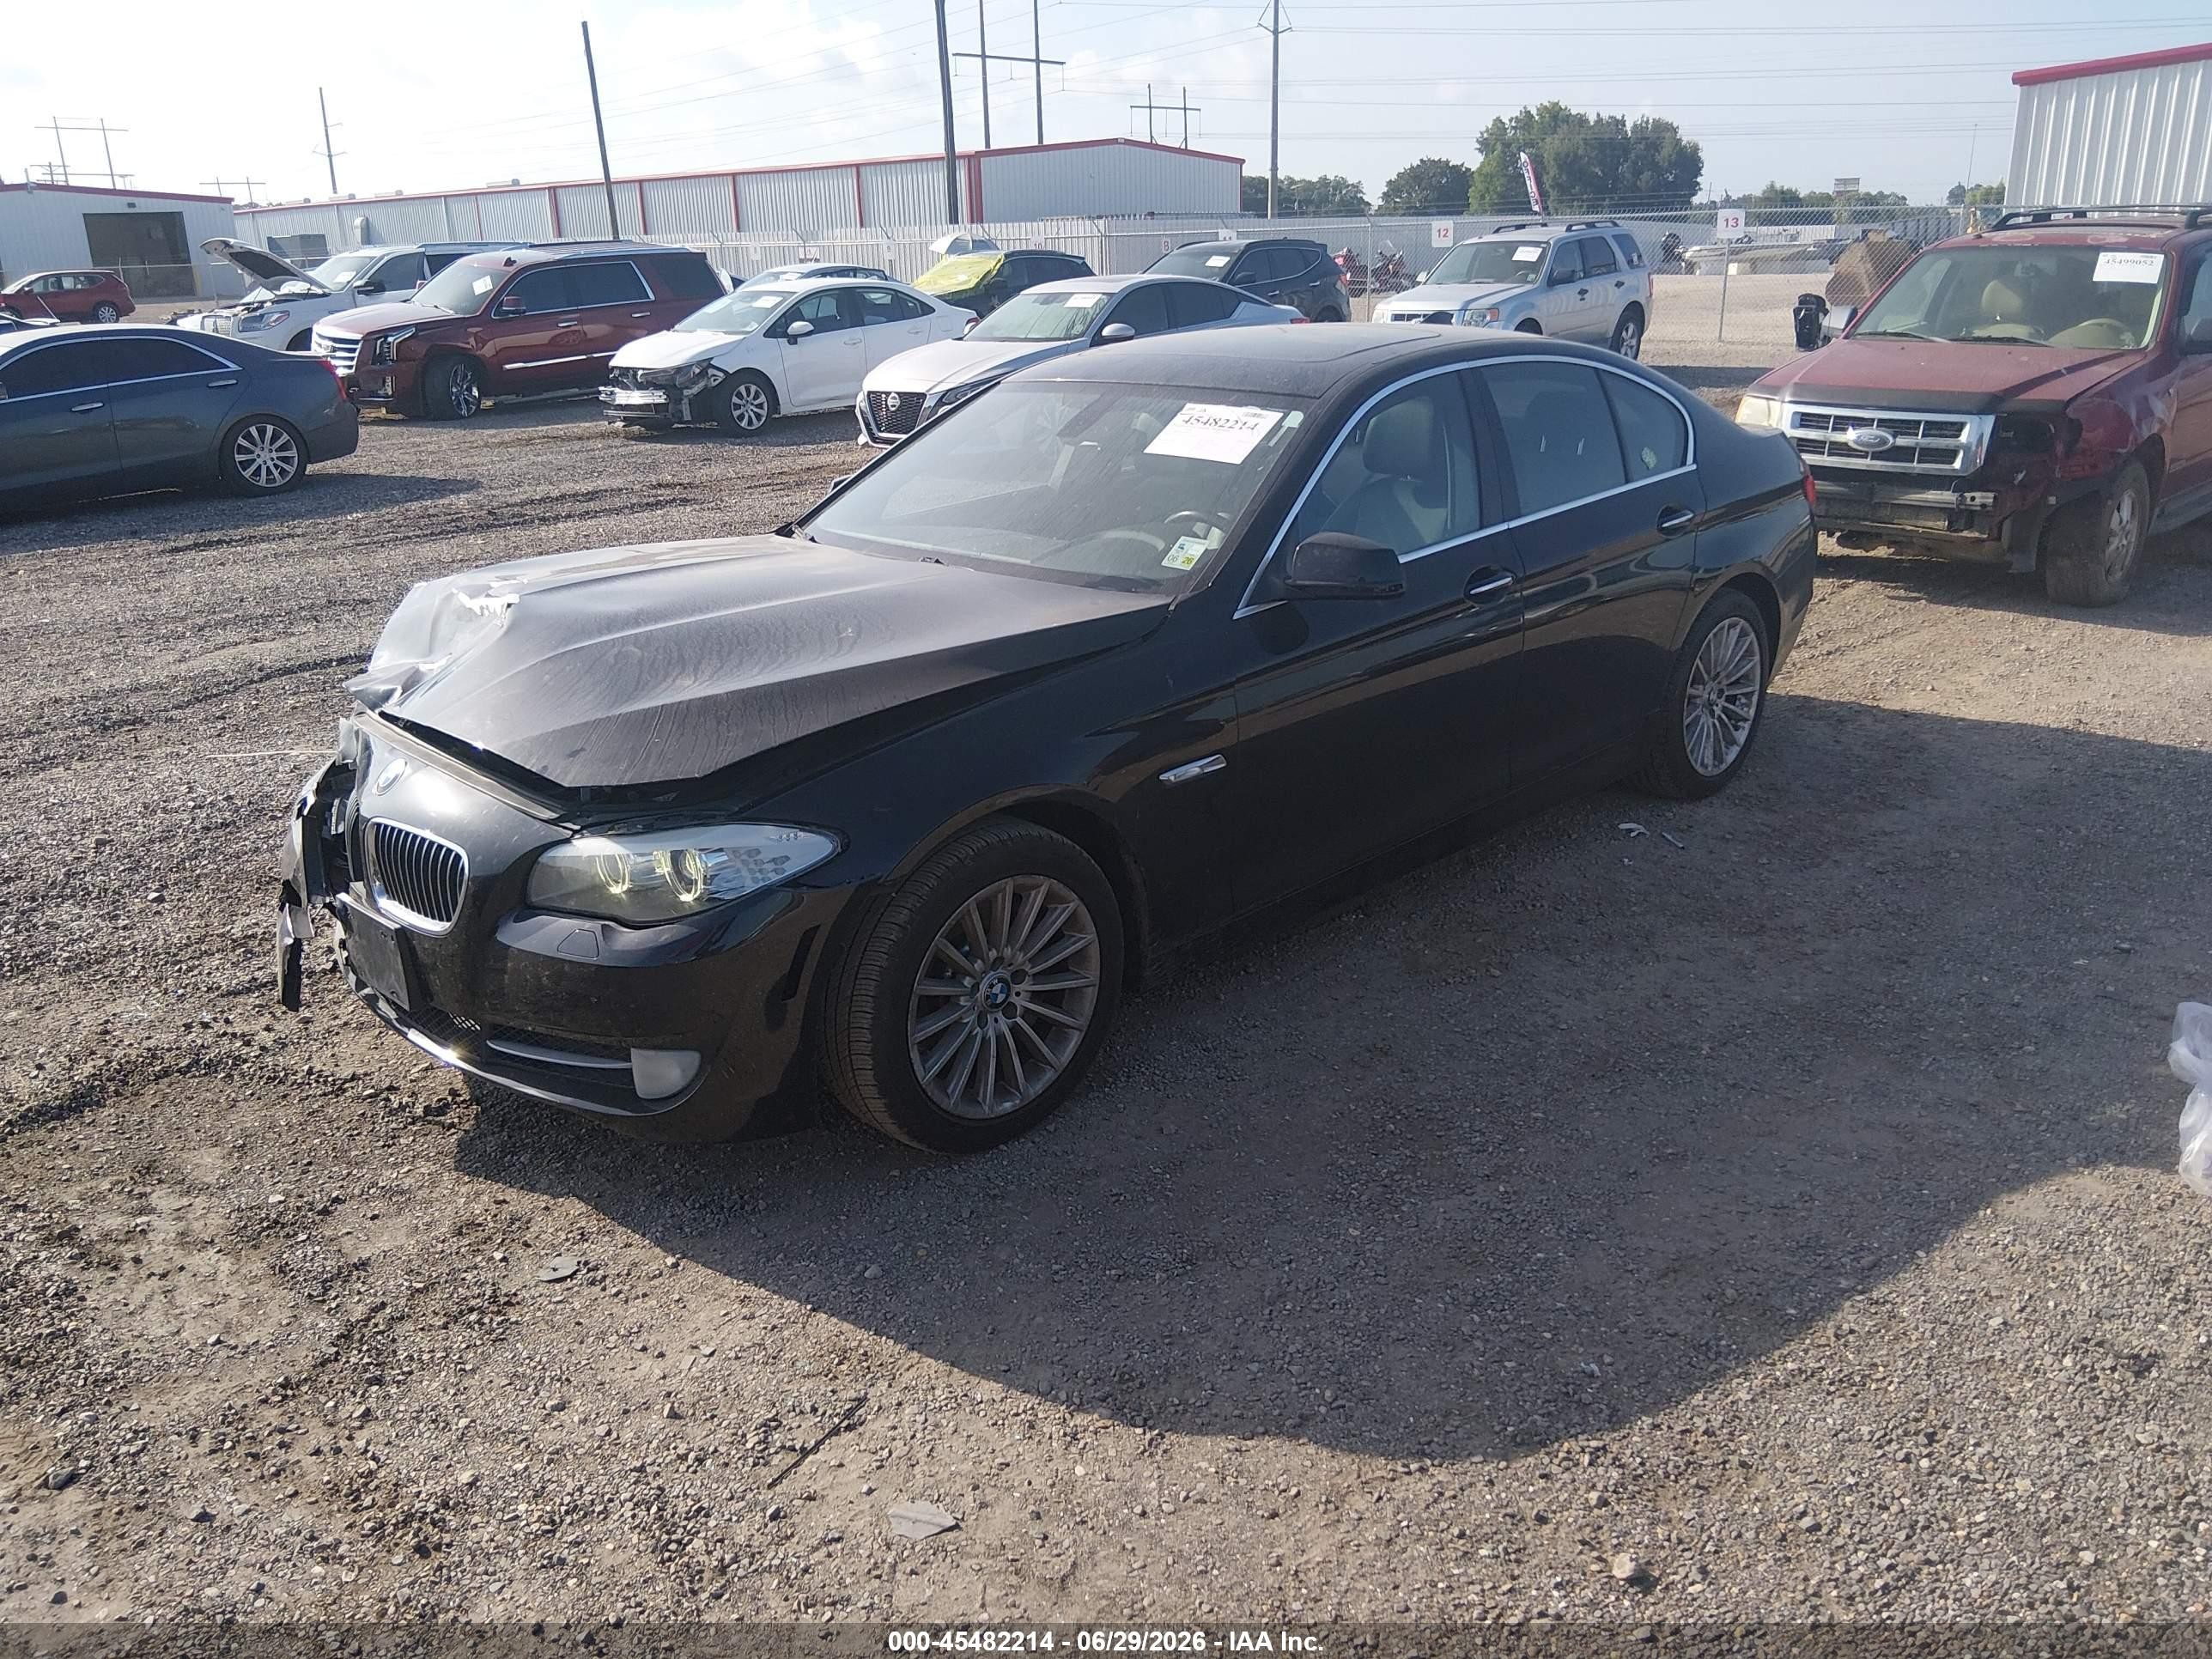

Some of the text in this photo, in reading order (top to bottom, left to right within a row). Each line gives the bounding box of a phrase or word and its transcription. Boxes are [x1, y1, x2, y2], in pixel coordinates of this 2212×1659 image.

[1724, 217, 1739, 228] 13
[1437, 228, 1449, 238] 12
[1182, 415, 1260, 430] 45482214
[1168, 555, 1179, 564] 06
